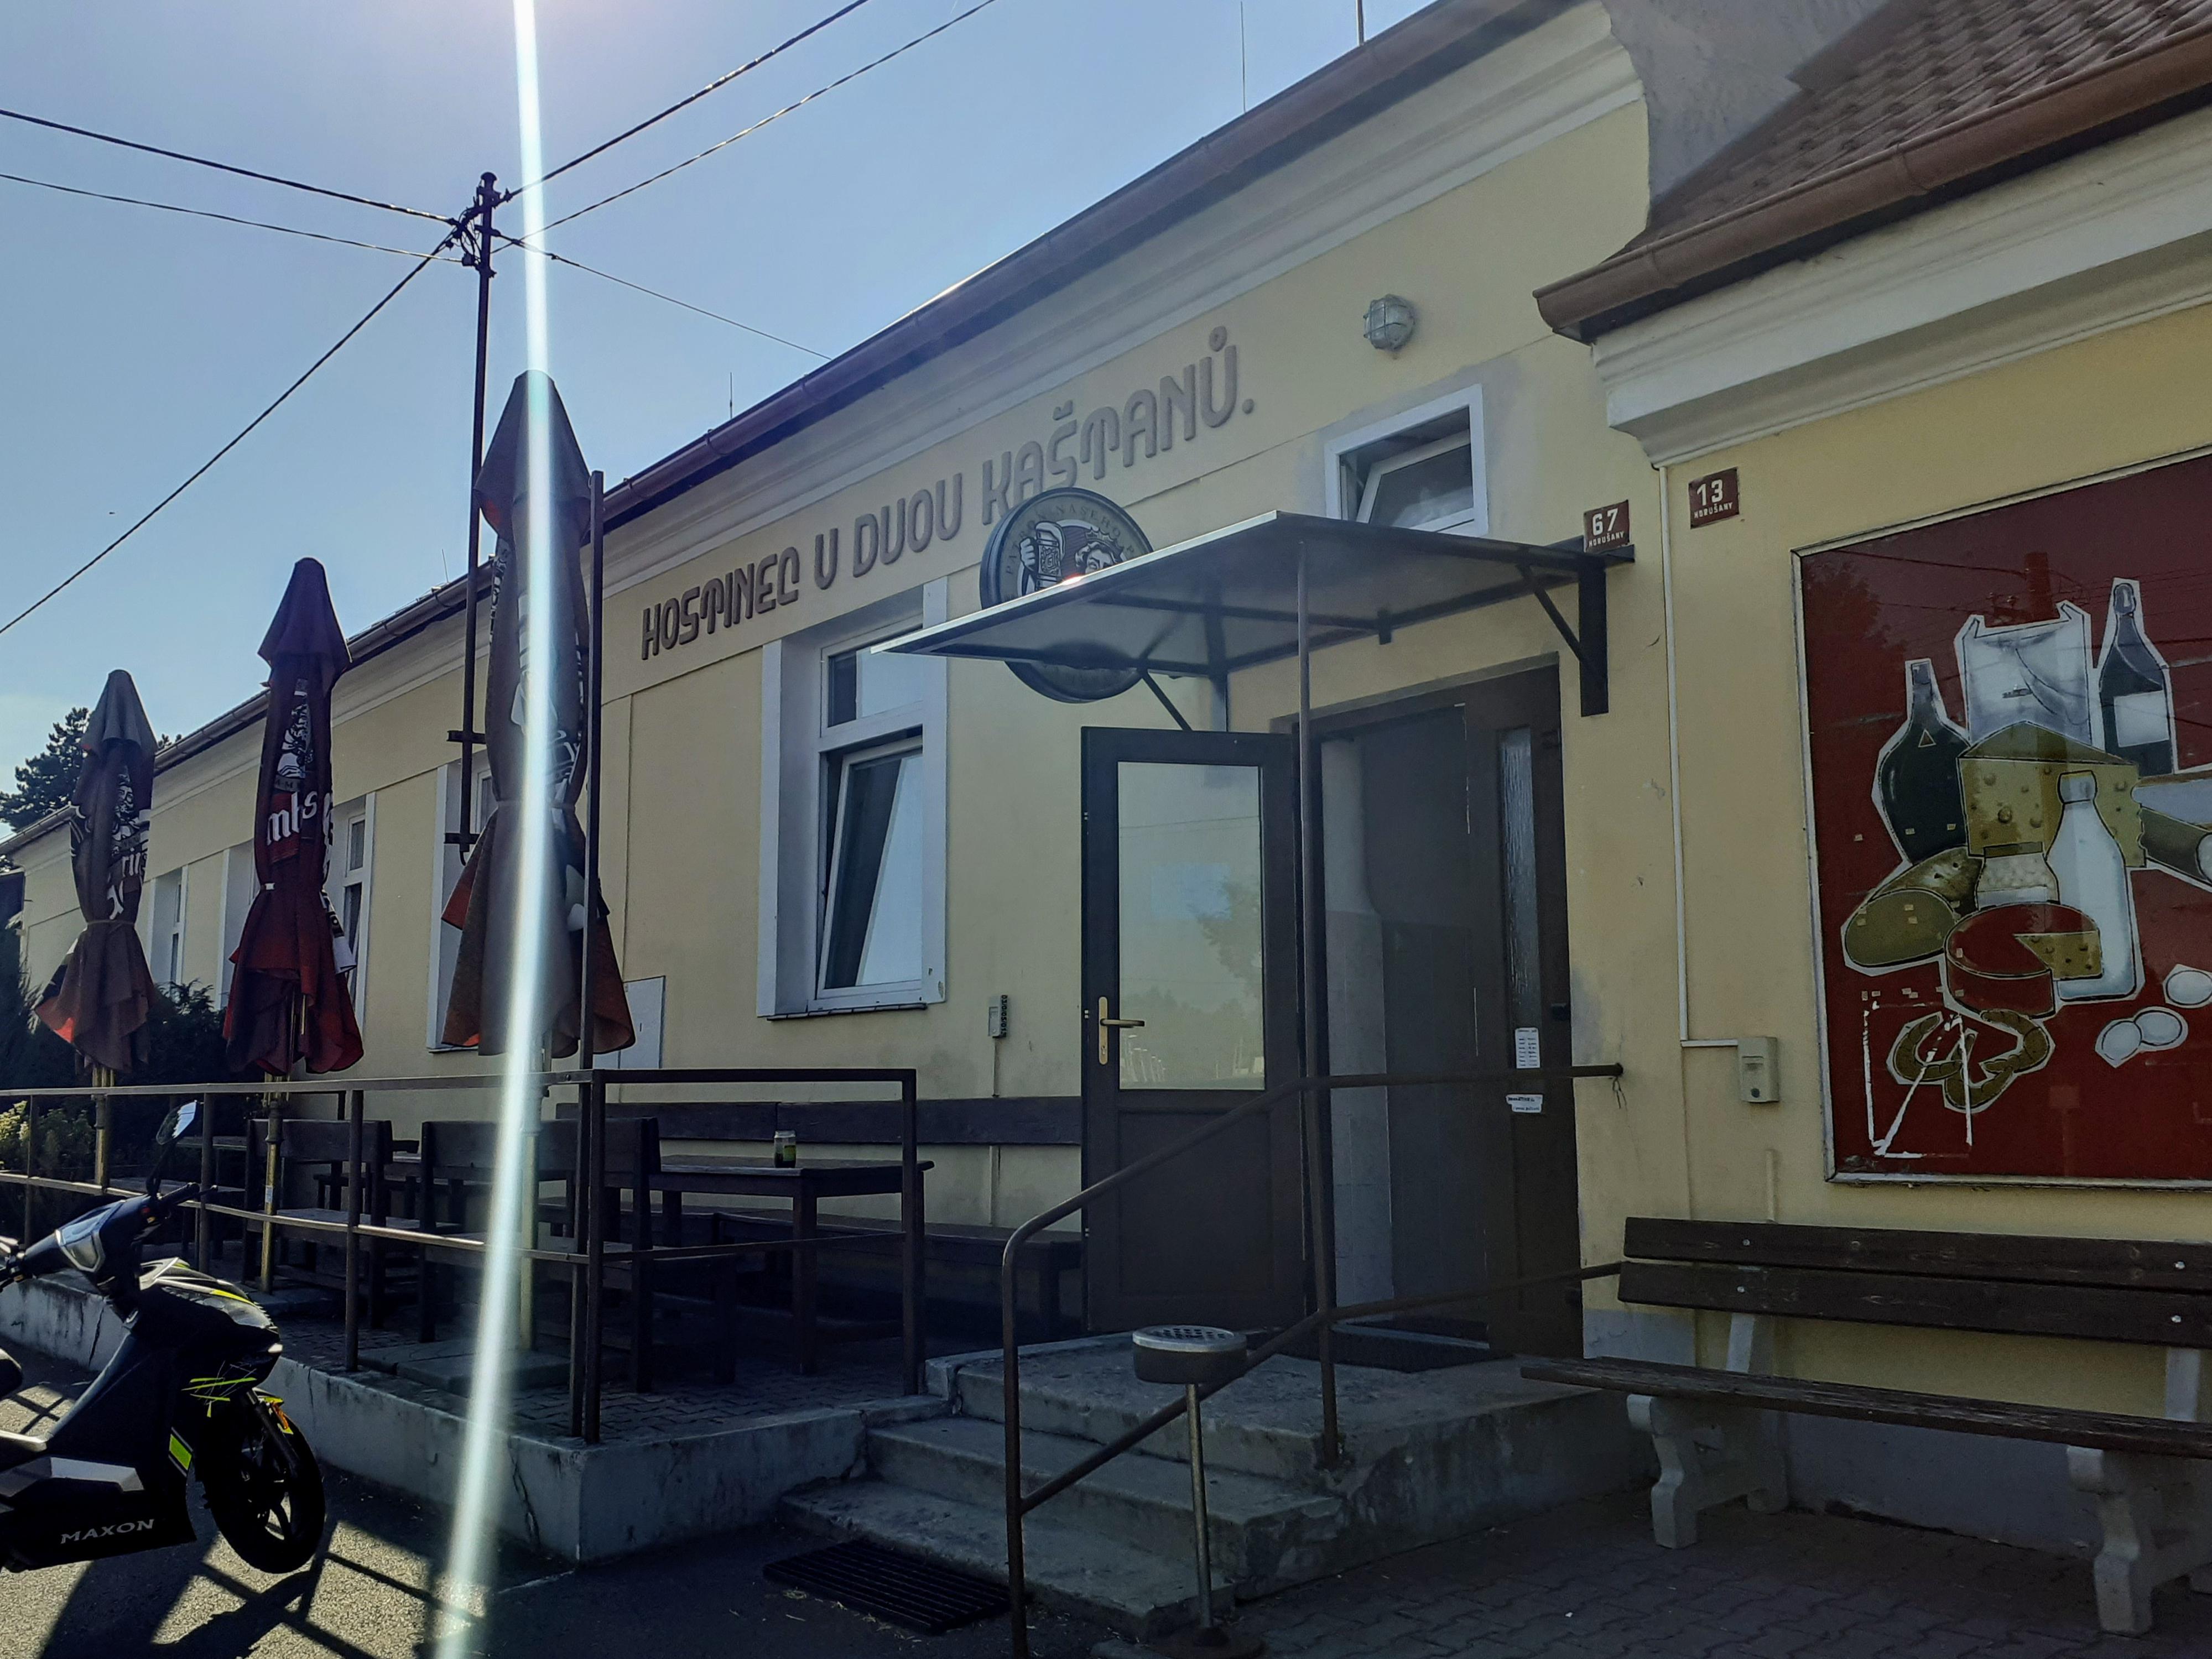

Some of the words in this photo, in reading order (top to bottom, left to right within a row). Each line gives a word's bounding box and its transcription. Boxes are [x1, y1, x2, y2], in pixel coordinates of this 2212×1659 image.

[1696, 479, 1723, 506] 13
[1592, 508, 1618, 536] 67
[1694, 502, 1733, 519] HORUŠANY
[1588, 531, 1625, 547] HORUŠANY
[641, 546, 800, 661] HOSTINEC
[814, 528, 838, 590] U
[60, 1519, 154, 1545] MAXON
